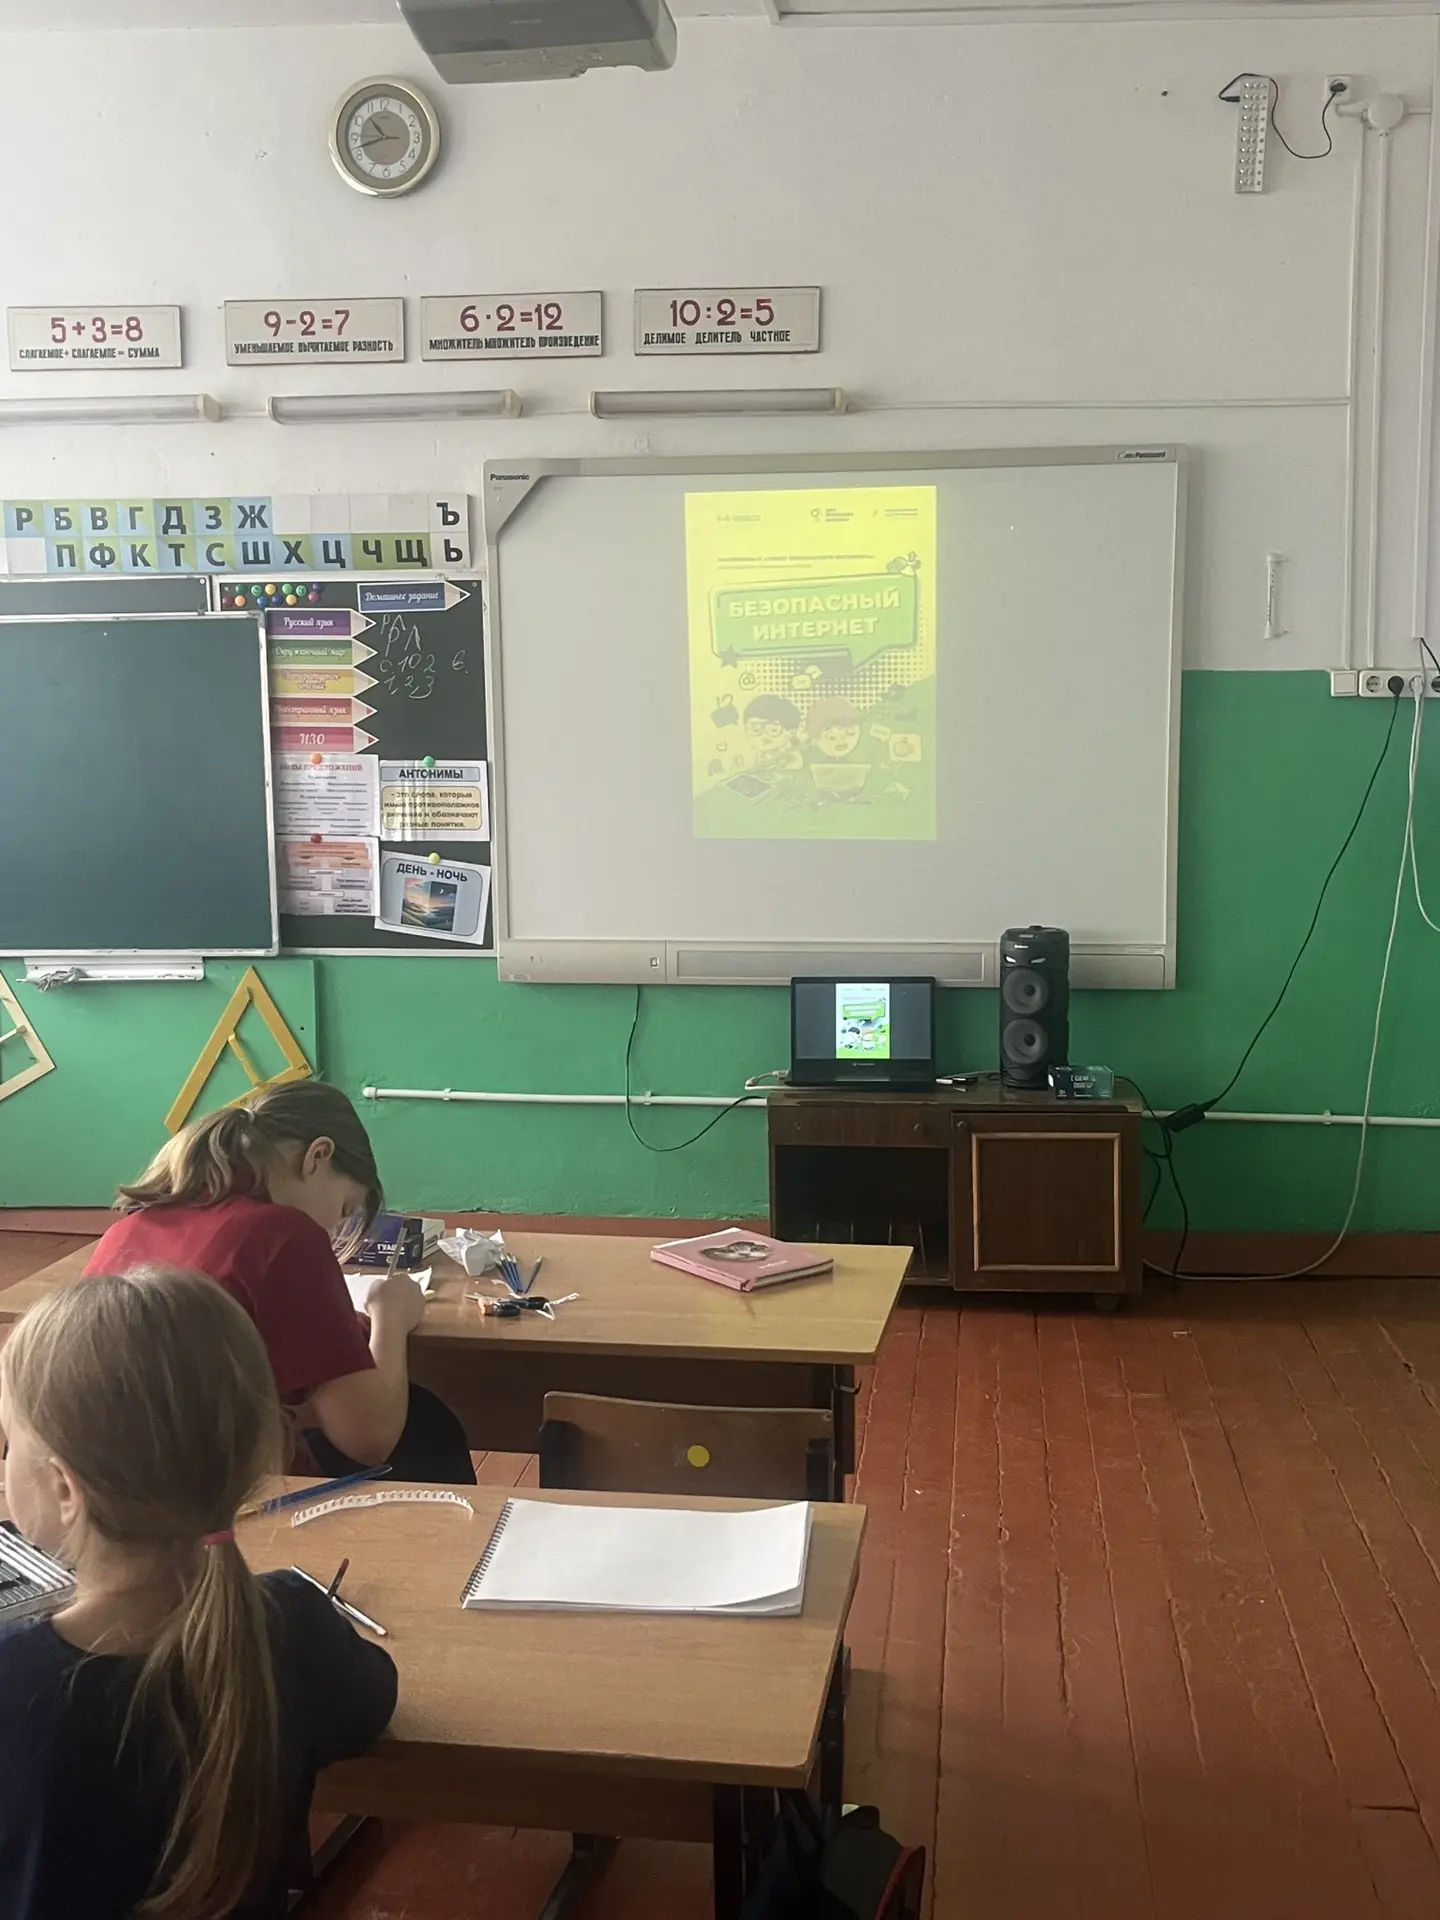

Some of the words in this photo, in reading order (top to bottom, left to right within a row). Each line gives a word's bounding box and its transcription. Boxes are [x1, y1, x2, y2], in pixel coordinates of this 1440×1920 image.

[366, 102, 374, 113] 11
[379, 99, 390, 111] 12
[398, 103, 402, 114] 1
[354, 115, 364, 127] 10
[407, 114, 416, 127] 2
[350, 132, 359, 144] 9
[412, 131, 420, 144] 3
[355, 150, 363, 161] 8
[407, 148, 416, 160] 4
[369, 162, 377, 173] 7
[399, 160, 407, 172] 5
[382, 167, 391, 178] 6
[429, 337, 483, 350] МНОЖИТЕЛЬ
[484, 336, 536, 349] МНОЖИТЕЛЬ
[538, 335, 600, 348] ПРОИЗВЕДЕНИЕ
[643, 332, 686, 345] ДЕЛИМОЕ
[695, 331, 742, 344] ДЕЛИТЕЛЬ
[750, 330, 791, 343] ЧАСТНОЕ
[71, 348, 117, 359] СЛАГАЕМОЕ
[128, 347, 160, 358] СУММА
[234, 342, 294, 354] УМЕНЬШАЕМОЕ
[298, 340, 350, 353] ВЫЧИТАЕМОЕ
[352, 340, 394, 351] РАЗНОСТЬ
[490, 473, 530, 481] Panasonic
[15, 507, 34, 531] Р
[53, 507, 73, 531] Б
[90, 507, 109, 531] В
[128, 506, 144, 530] Г
[162, 505, 187, 535] Д
[205, 505, 223, 530] З
[237, 504, 268, 529] Ж
[436, 502, 460, 526] Ъ
[56, 544, 77, 568] П
[89, 542, 116, 569] Ф
[131, 543, 151, 567] К
[168, 543, 185, 567] Т
[205, 543, 226, 567] С
[241, 541, 271, 565] Ш
[282, 540, 305, 565] Х
[322, 540, 346, 569] Ц
[362, 539, 383, 563] Ч
[395, 539, 429, 568] Щ
[444, 538, 463, 562] Ь
[365, 591, 406, 602] Домашнее
[407, 591, 439, 604] задание
[728, 585, 901, 619] БЕЗОПАСНЫЙ
[283, 616, 315, 630] Русский
[315, 619, 334, 630] язык
[752, 617, 879, 642] ИНТЕРНЕТ
[299, 733, 325, 745] ИЗО
[399, 769, 464, 779] АНТОНИМЫ
[439, 791, 472, 799] которые
[396, 863, 428, 876] ДЕНЬ
[436, 868, 468, 882] НОЧЬ
